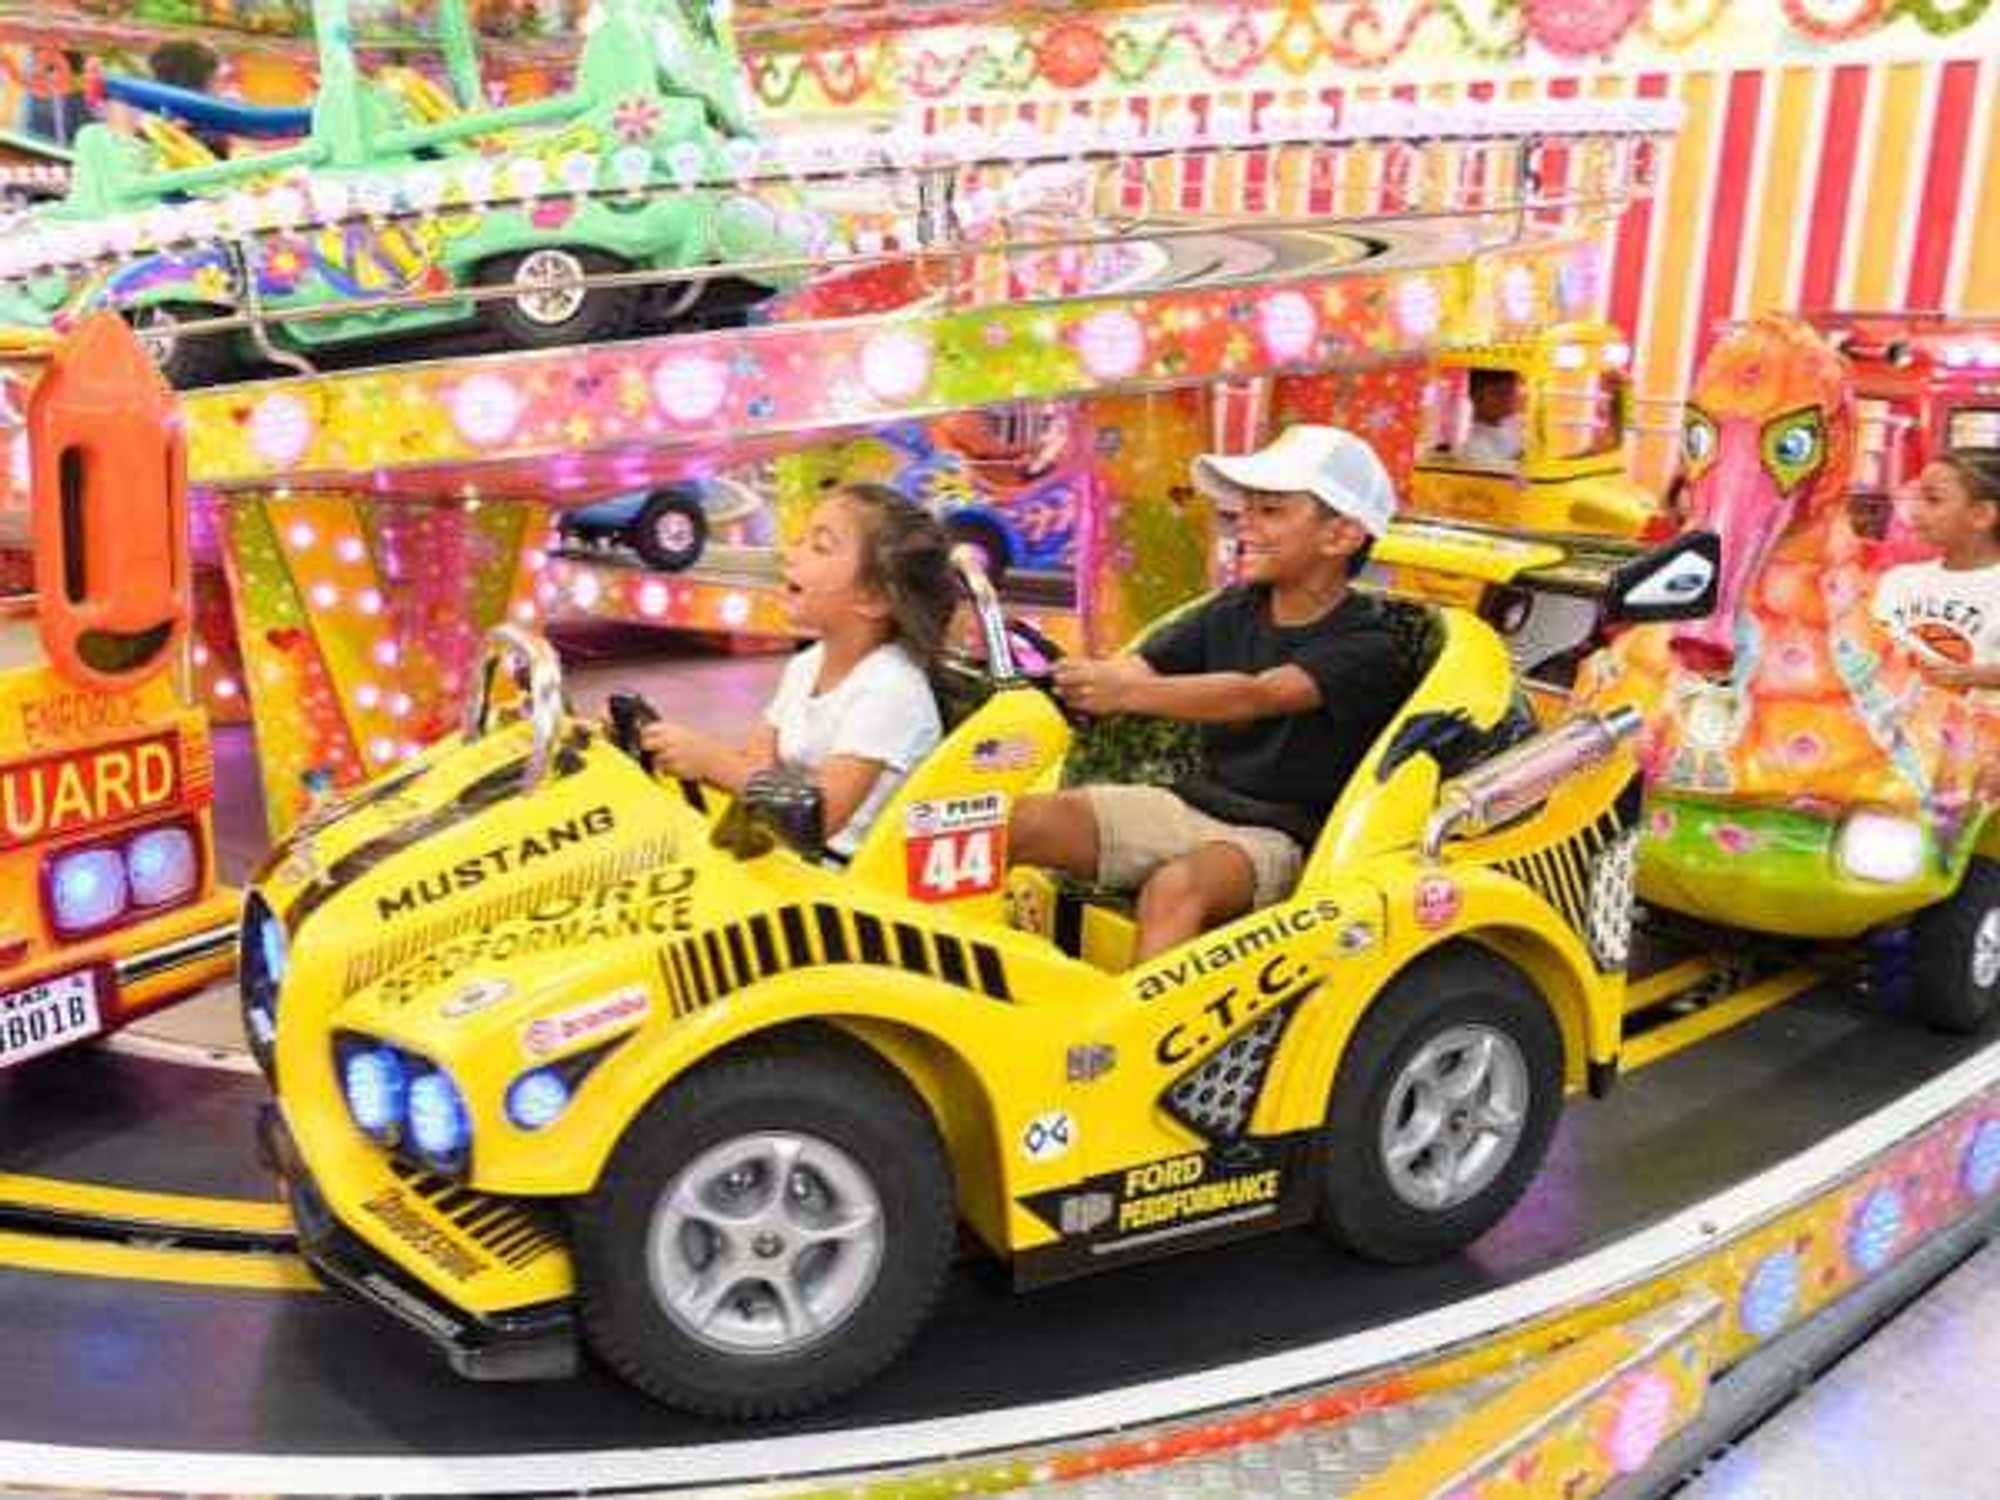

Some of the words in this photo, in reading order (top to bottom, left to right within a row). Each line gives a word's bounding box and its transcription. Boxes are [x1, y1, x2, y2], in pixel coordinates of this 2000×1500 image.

[3, 742, 174, 840] UARD
[376, 806, 614, 919] MUSTANG
[921, 829, 991, 894] 44
[1136, 900, 1340, 1001] aviamics
[1157, 953, 1309, 1066] C.T.C.
[1125, 1153, 1205, 1198] FORD
